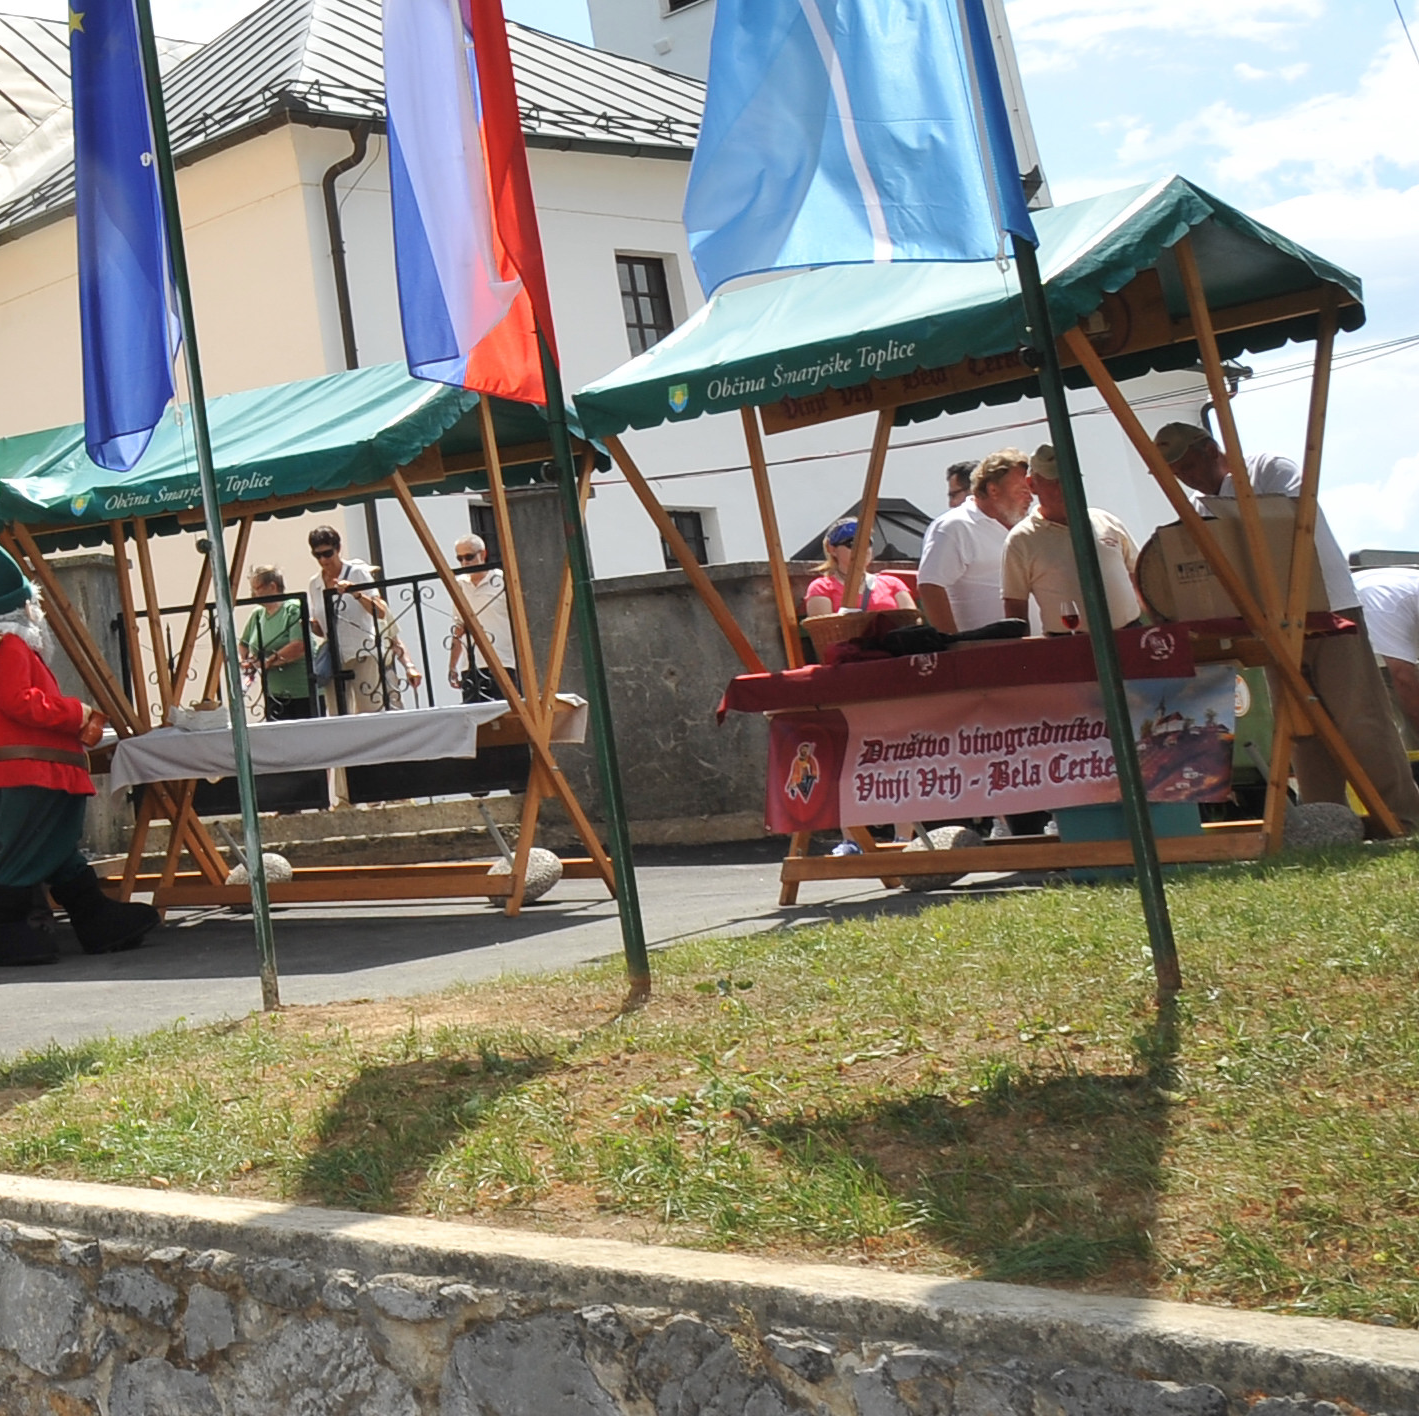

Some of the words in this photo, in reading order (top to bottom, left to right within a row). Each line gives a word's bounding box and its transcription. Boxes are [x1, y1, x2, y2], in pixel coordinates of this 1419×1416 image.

[707, 377, 766, 400] Občina
[771, 352, 851, 387] Šmarješke
[856, 340, 916, 371] Toplice
[104, 493, 151, 510] Občina
[225, 472, 274, 495] Toplice
[858, 733, 950, 767] Društvo
[855, 770, 910, 804] Vinji
[918, 766, 962, 800] Vrh
[988, 755, 1041, 796] Bela
[1049, 747, 1118, 783] Cerke
